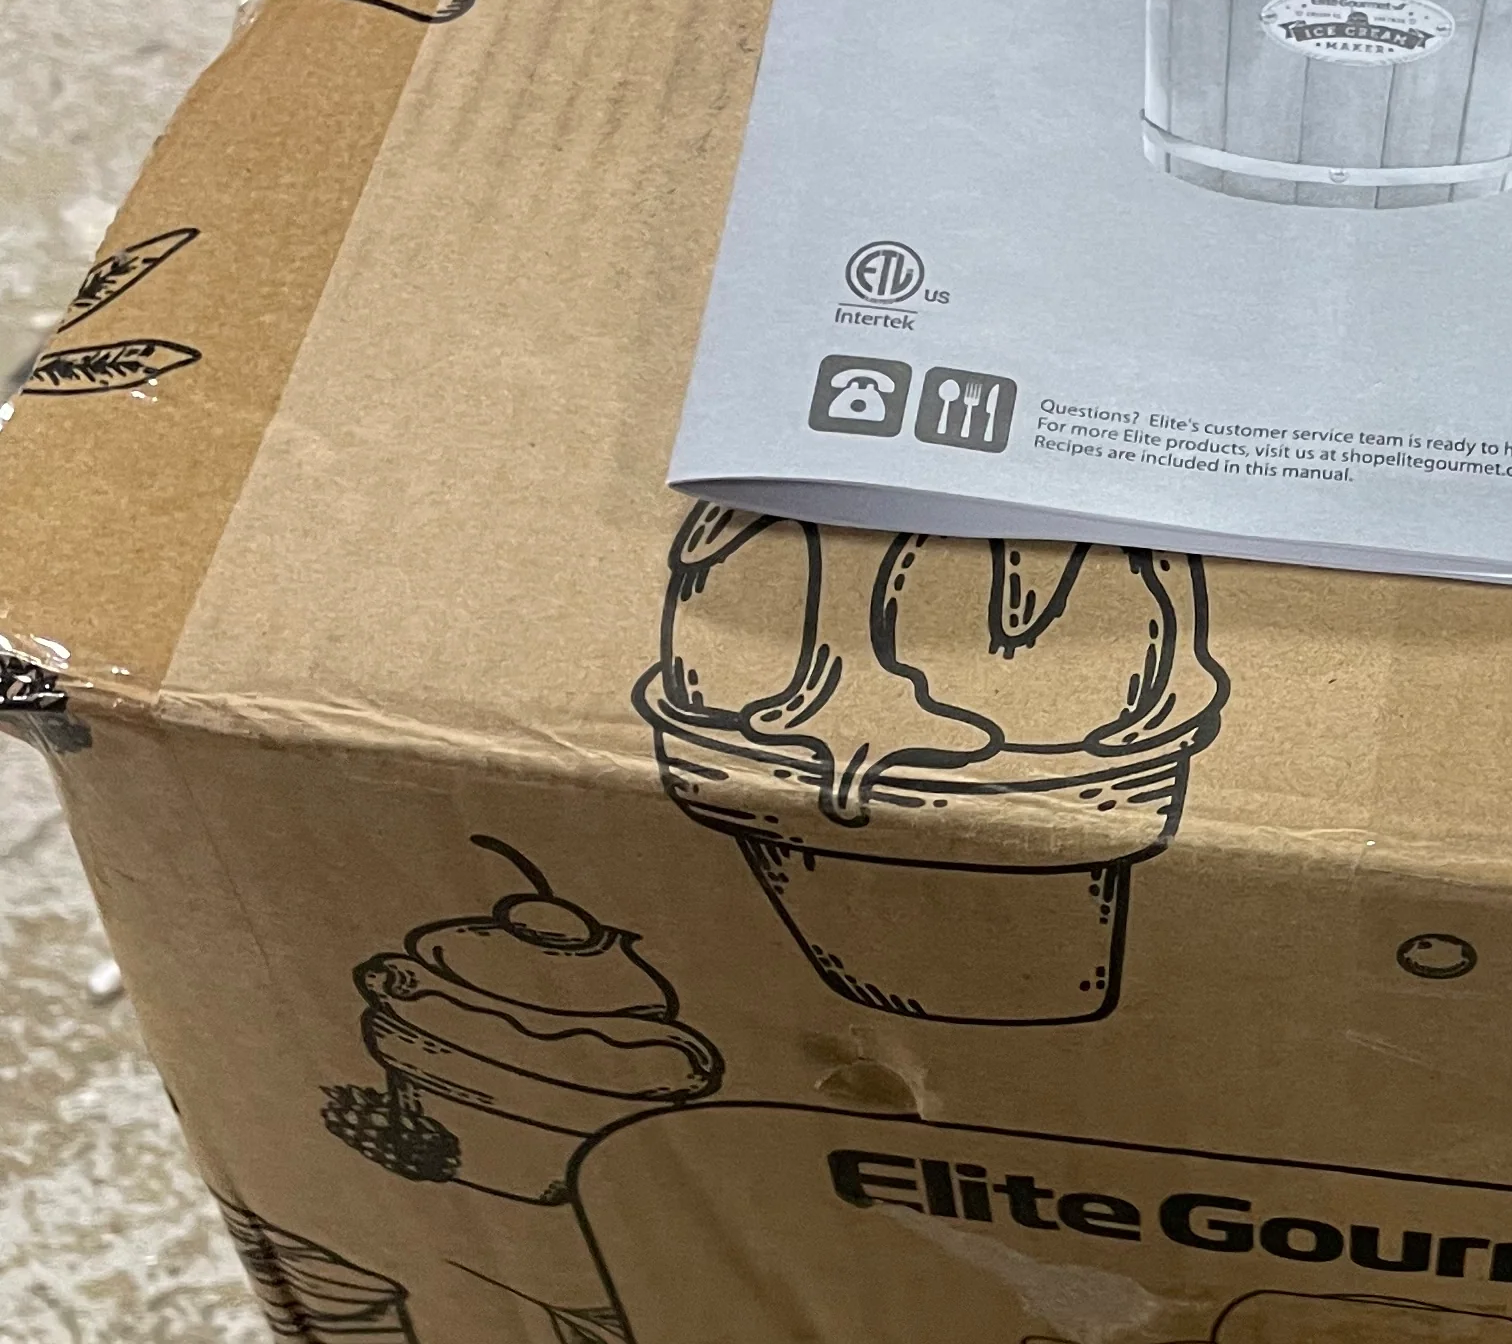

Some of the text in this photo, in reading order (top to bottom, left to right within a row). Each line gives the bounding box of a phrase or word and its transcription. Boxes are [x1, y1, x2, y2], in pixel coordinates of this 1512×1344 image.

[1303, 25, 1408, 45] ICE CREAM
[1325, 41, 1385, 54] MAKER
[834, 307, 917, 331] Intertek
[1037, 416, 1067, 433] For
[1070, 423, 1119, 441] more
[1123, 429, 1161, 447] Elite
[1165, 437, 1250, 458] products,
[1255, 443, 1290, 459] visit
[1296, 447, 1315, 460] us
[1319, 448, 1337, 462] at
[1039, 398, 1140, 425] Questions?
[1149, 413, 1200, 433] Elite's
[1204, 422, 1289, 440] customer
[1292, 428, 1354, 444] service
[1359, 432, 1403, 448] team
[1408, 434, 1422, 449] is
[1426, 437, 1476, 457] ready
[1481, 441, 1499, 456] to
[1034, 435, 1354, 483] Recipes are included in this manual.
[827, 1148, 1142, 1241] Elite
